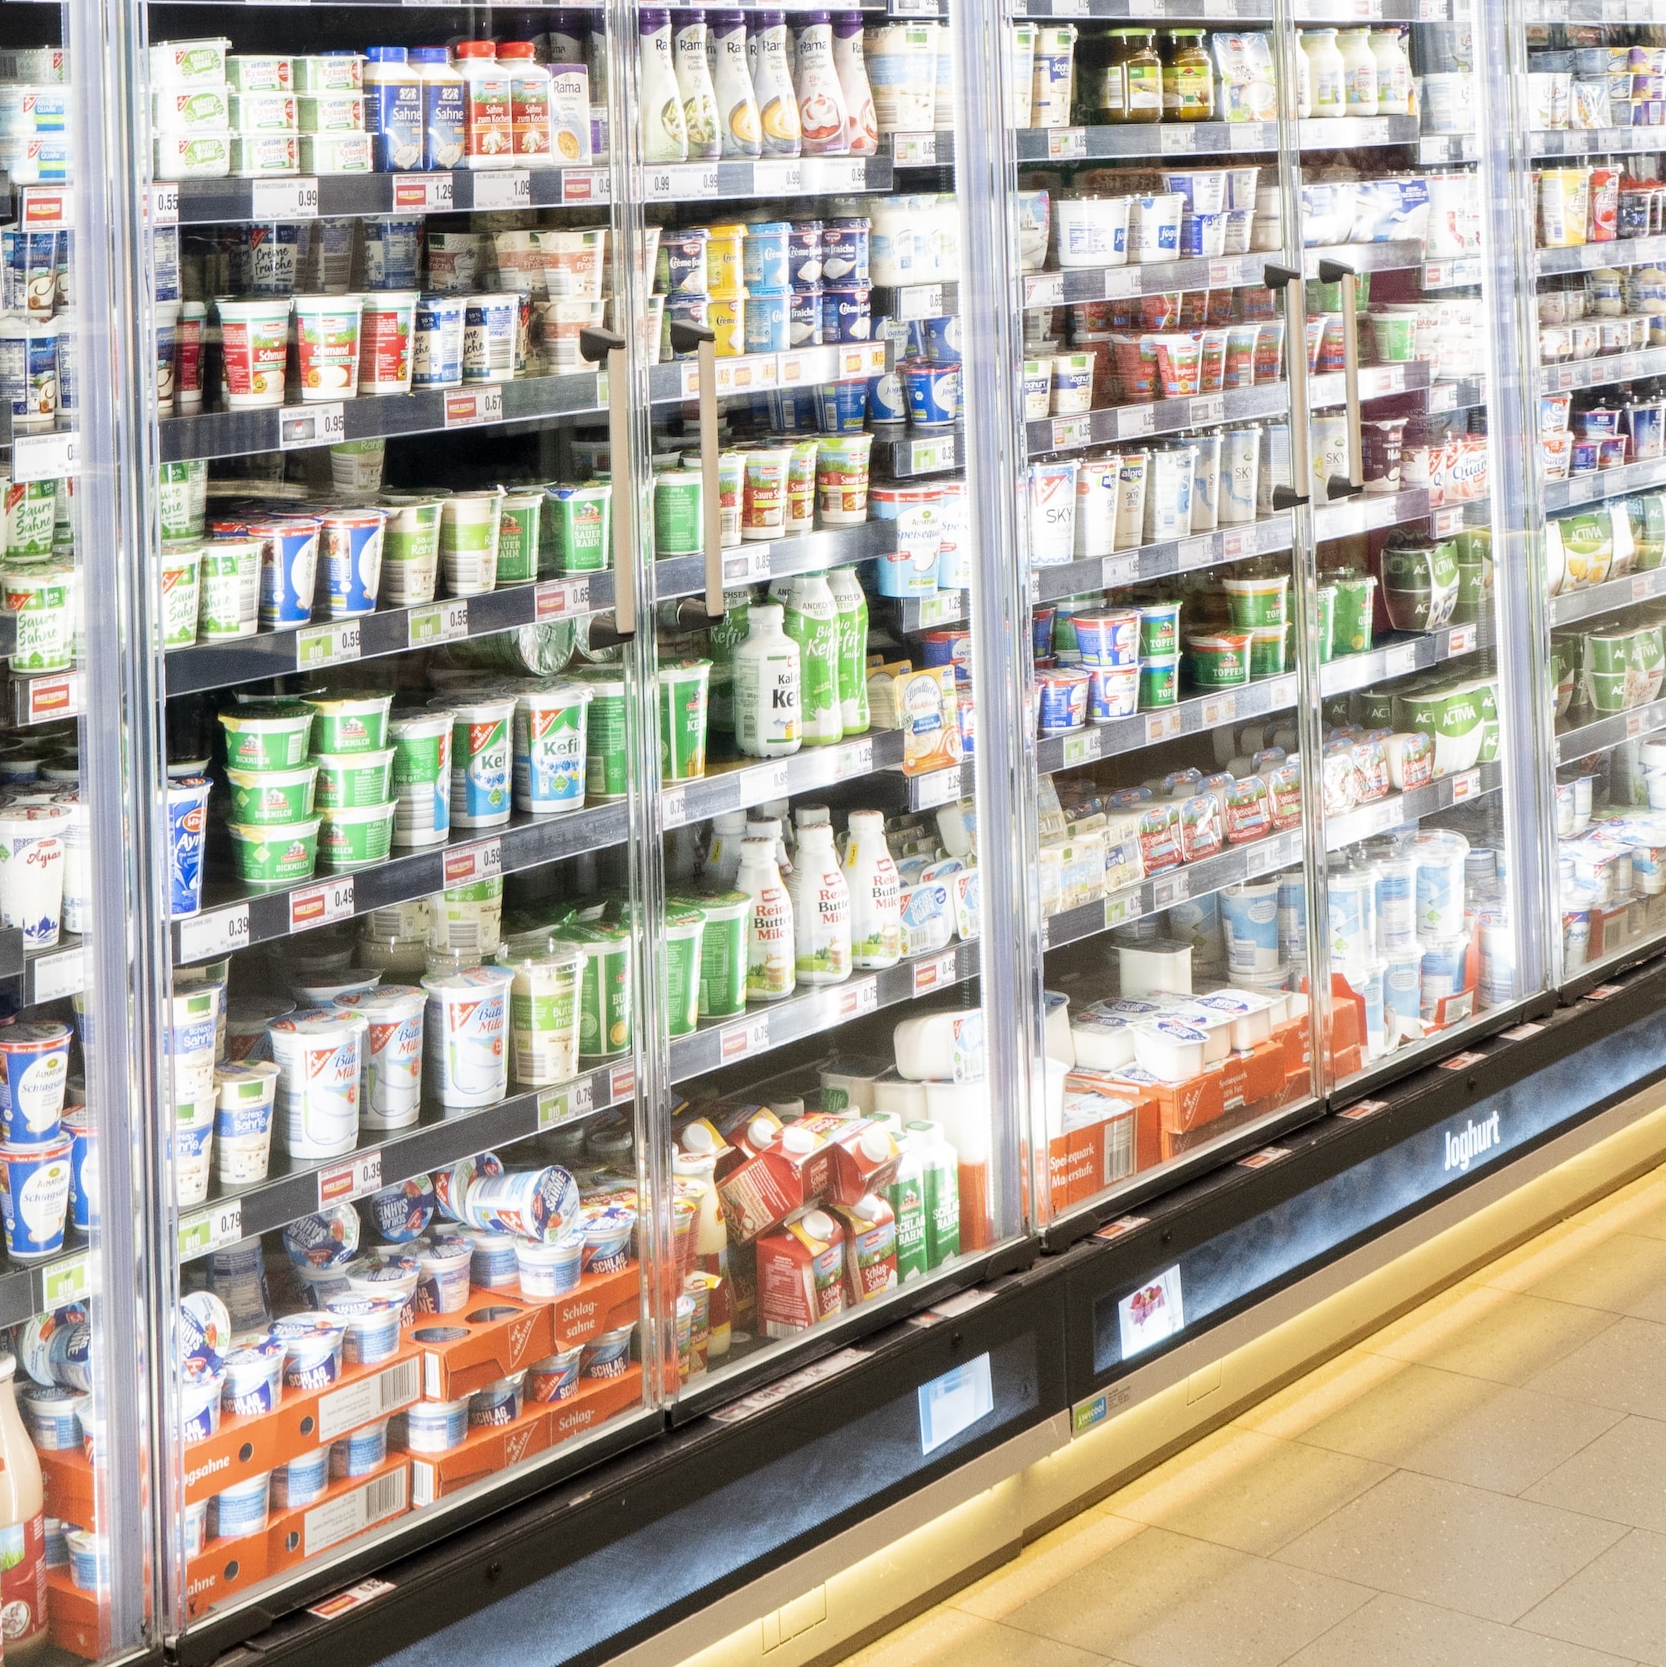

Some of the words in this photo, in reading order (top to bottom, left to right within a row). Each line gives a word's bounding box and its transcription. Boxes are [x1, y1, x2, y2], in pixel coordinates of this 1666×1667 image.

[553, 79, 582, 95] Rama
[392, 105, 422, 122] Sahne
[486, 104, 504, 114] Sahne
[435, 183, 453, 201] 1.29
[514, 180, 530, 197] 1.09
[654, 176, 669, 191] 0.99
[484, 394, 502, 411] 0.67
[325, 415, 344, 434] 0.95
[1120, 467, 1143, 482] alpro
[574, 529, 601, 541] SAUER
[575, 537, 602, 549] RAHM
[342, 629, 361, 649] 0.59
[1211, 664, 1245, 679] TOPFEN
[254, 807, 293, 820] DICKMILCH
[26, 847, 62, 869] Ayran
[483, 845, 501, 866] 0.59
[275, 861, 311, 875] DICKMILCH
[335, 887, 354, 909] 0.49
[229, 915, 250, 938] 0.39
[1445, 1111, 1500, 1172] Joghurt
[898, 1230, 924, 1247] RAHM
[561, 1300, 599, 1323] Schlag-
[566, 1316, 596, 1337] sahne
